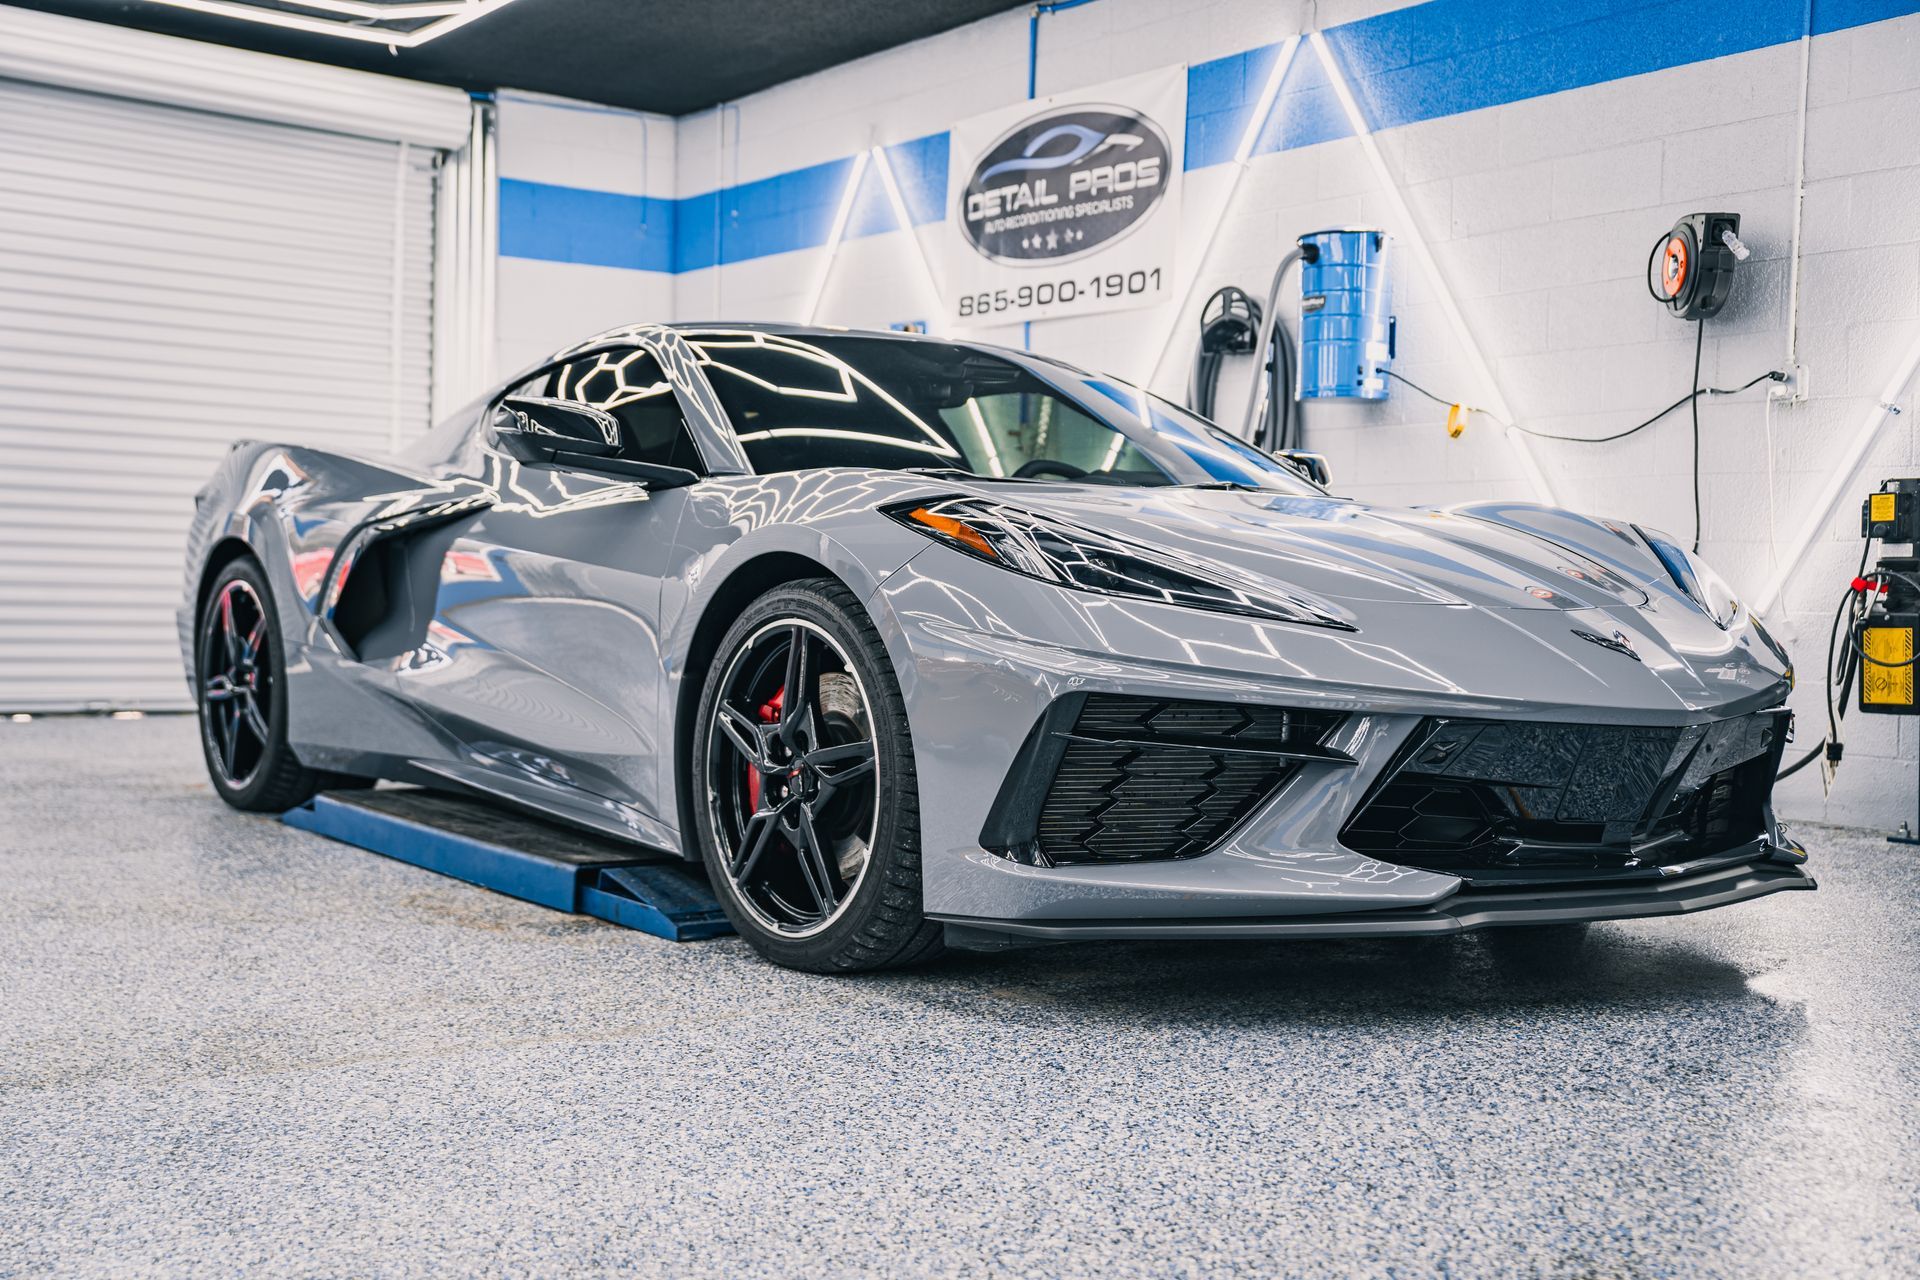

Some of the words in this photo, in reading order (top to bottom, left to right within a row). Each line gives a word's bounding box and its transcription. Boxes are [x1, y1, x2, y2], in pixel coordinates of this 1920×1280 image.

[968, 179, 1058, 222] DETAIL
[1069, 157, 1160, 200] PROS
[1075, 195, 1134, 219] SPECIALISTS
[959, 267, 1161, 317] 865-900-1901
